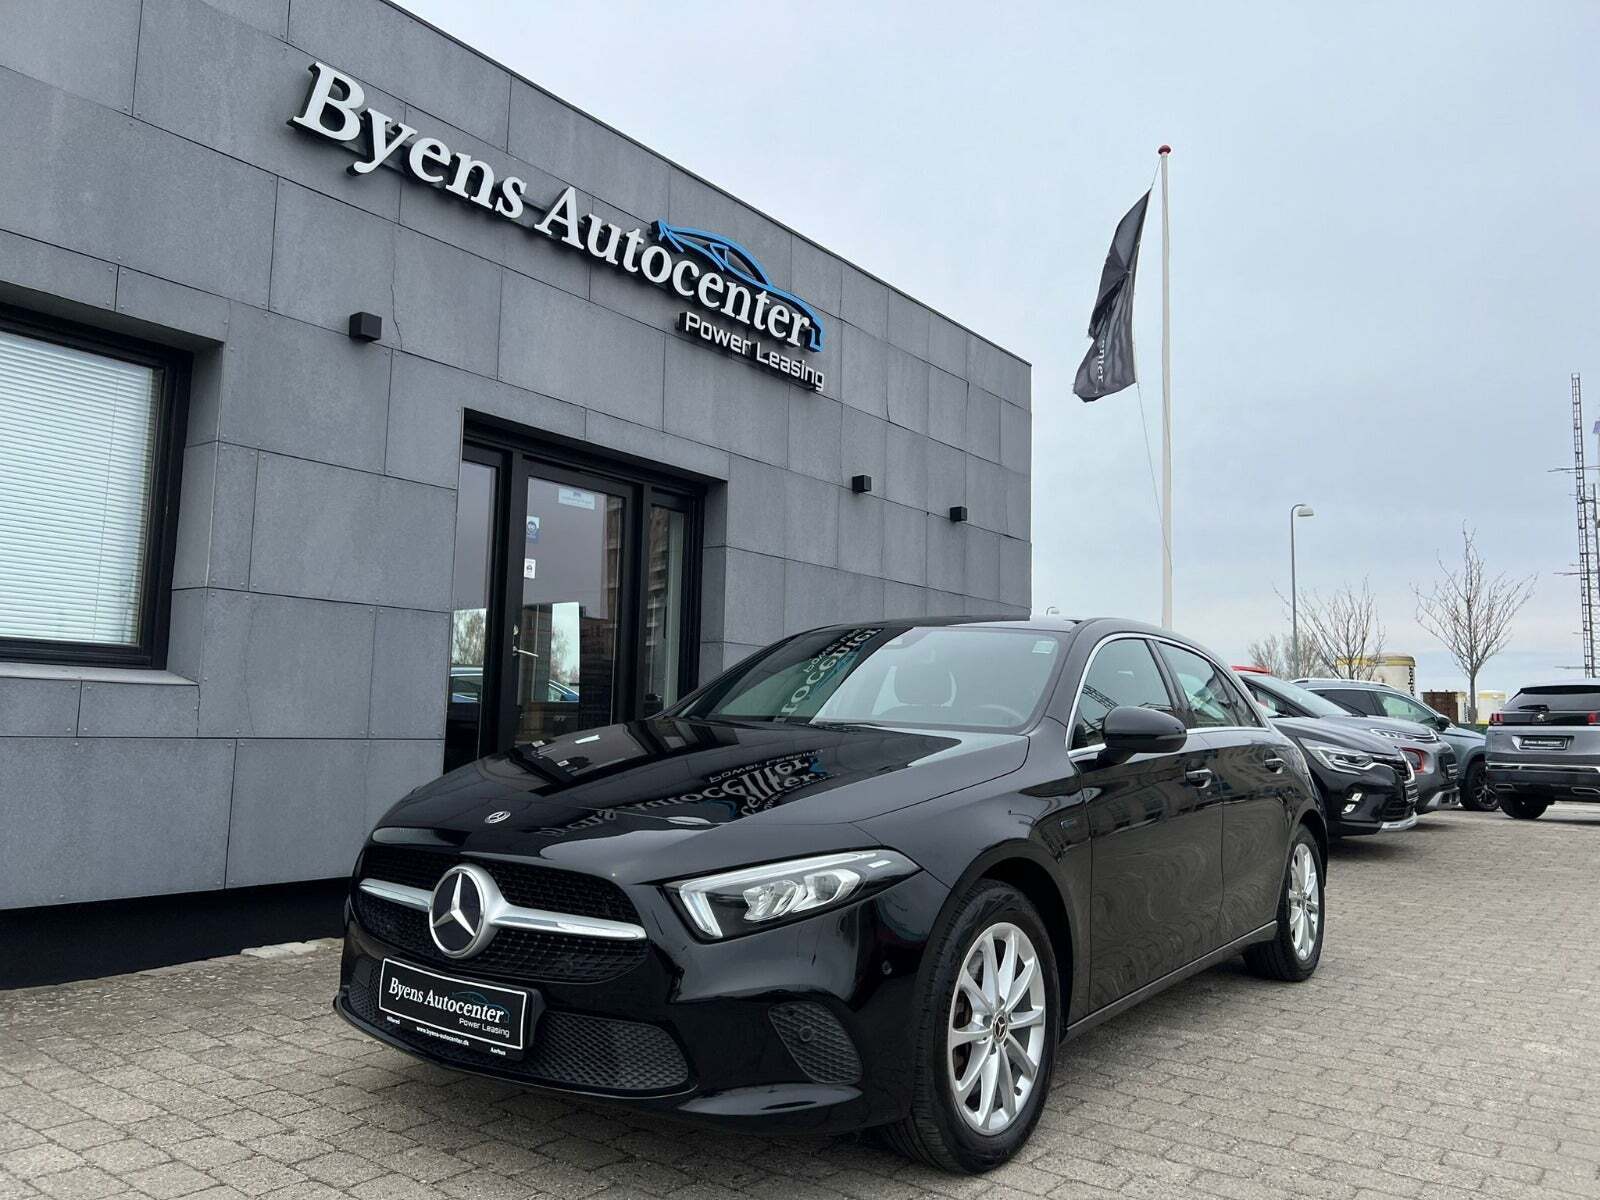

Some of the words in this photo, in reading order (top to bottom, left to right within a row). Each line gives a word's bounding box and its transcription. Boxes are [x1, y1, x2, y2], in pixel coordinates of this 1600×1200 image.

[291, 62, 527, 219] Byens
[534, 186, 811, 349] Autocenter
[684, 311, 751, 356] Power
[756, 341, 825, 391] Leasing
[388, 976, 424, 1003] Byens
[424, 989, 505, 1024] Autocenter
[459, 1017, 481, 1031] Power
[482, 1022, 510, 1038] Leasing
